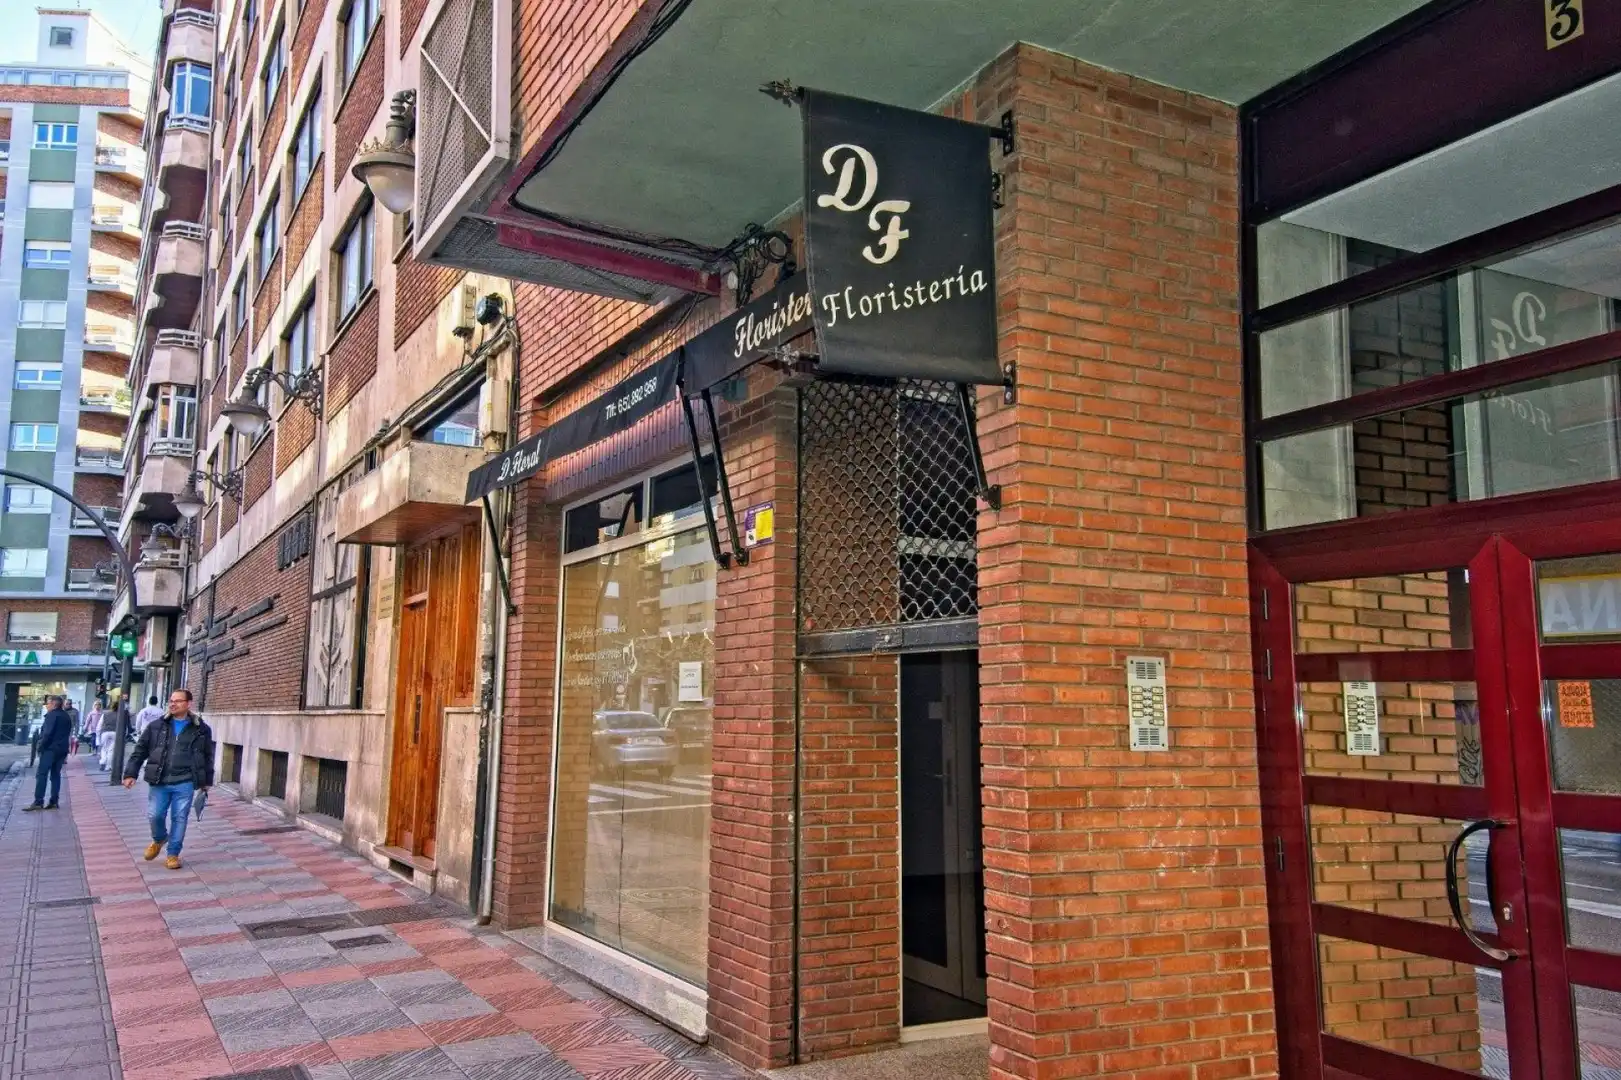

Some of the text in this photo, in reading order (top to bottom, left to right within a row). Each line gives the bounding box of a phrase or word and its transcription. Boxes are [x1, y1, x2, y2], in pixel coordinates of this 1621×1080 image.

[1550, 0, 1580, 41] 3
[817, 143, 878, 212] D
[862, 200, 911, 265] F
[822, 264, 988, 328] Floristería
[497, 438, 542, 482] D Floral
